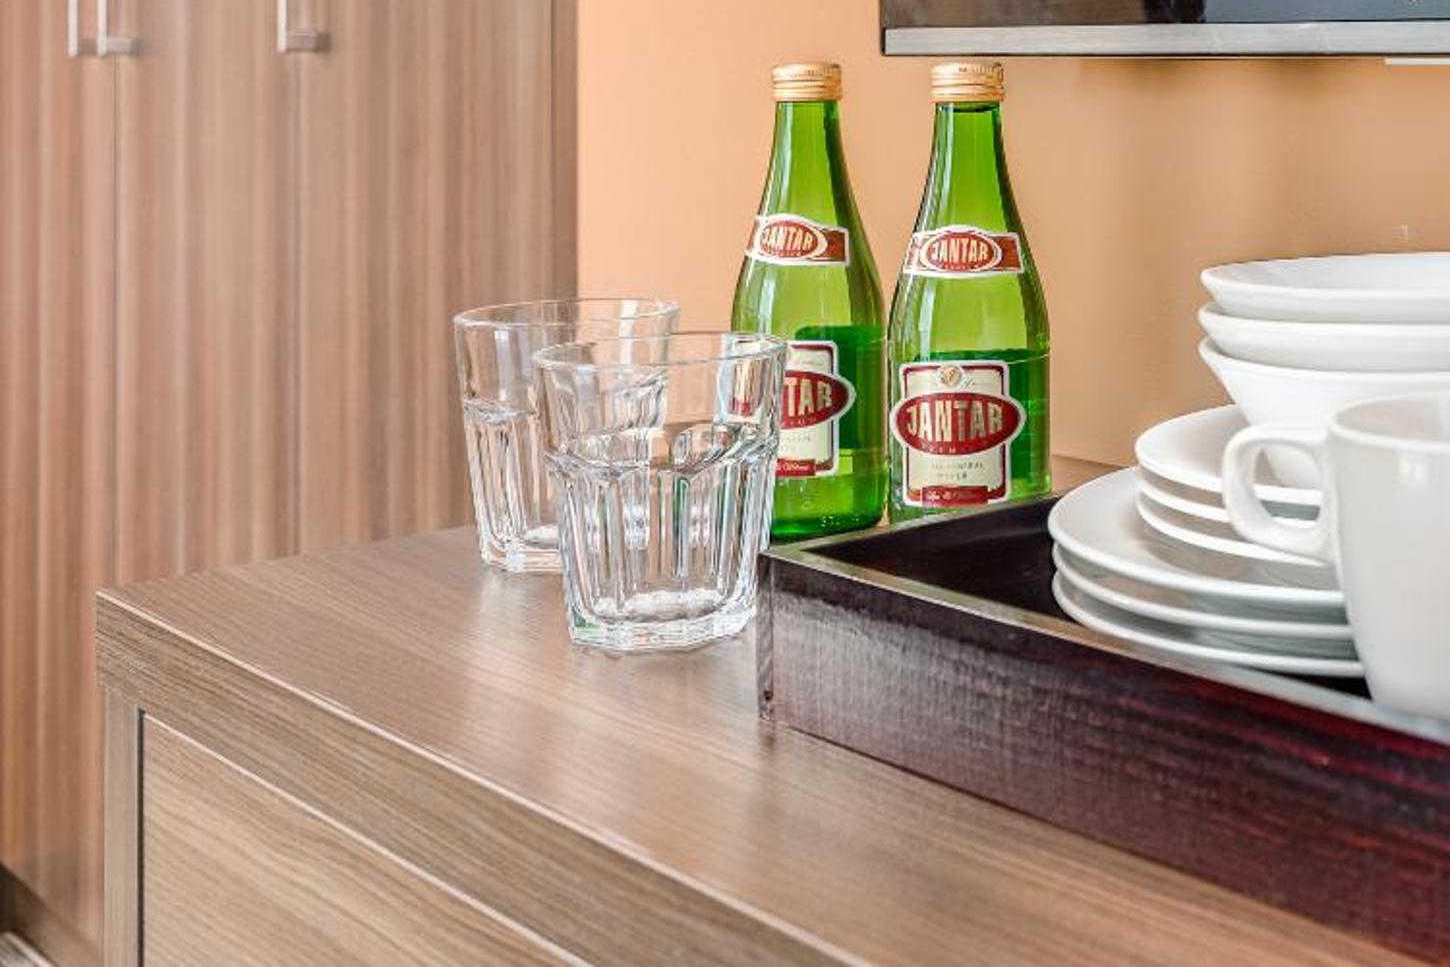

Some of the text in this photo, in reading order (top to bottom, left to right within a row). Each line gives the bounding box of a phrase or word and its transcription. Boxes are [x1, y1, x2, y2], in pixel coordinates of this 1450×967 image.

[762, 225, 813, 251] JANTAR
[931, 237, 989, 264] JANTAR
[784, 376, 832, 418] TAR
[906, 399, 1003, 443] JANTAR
